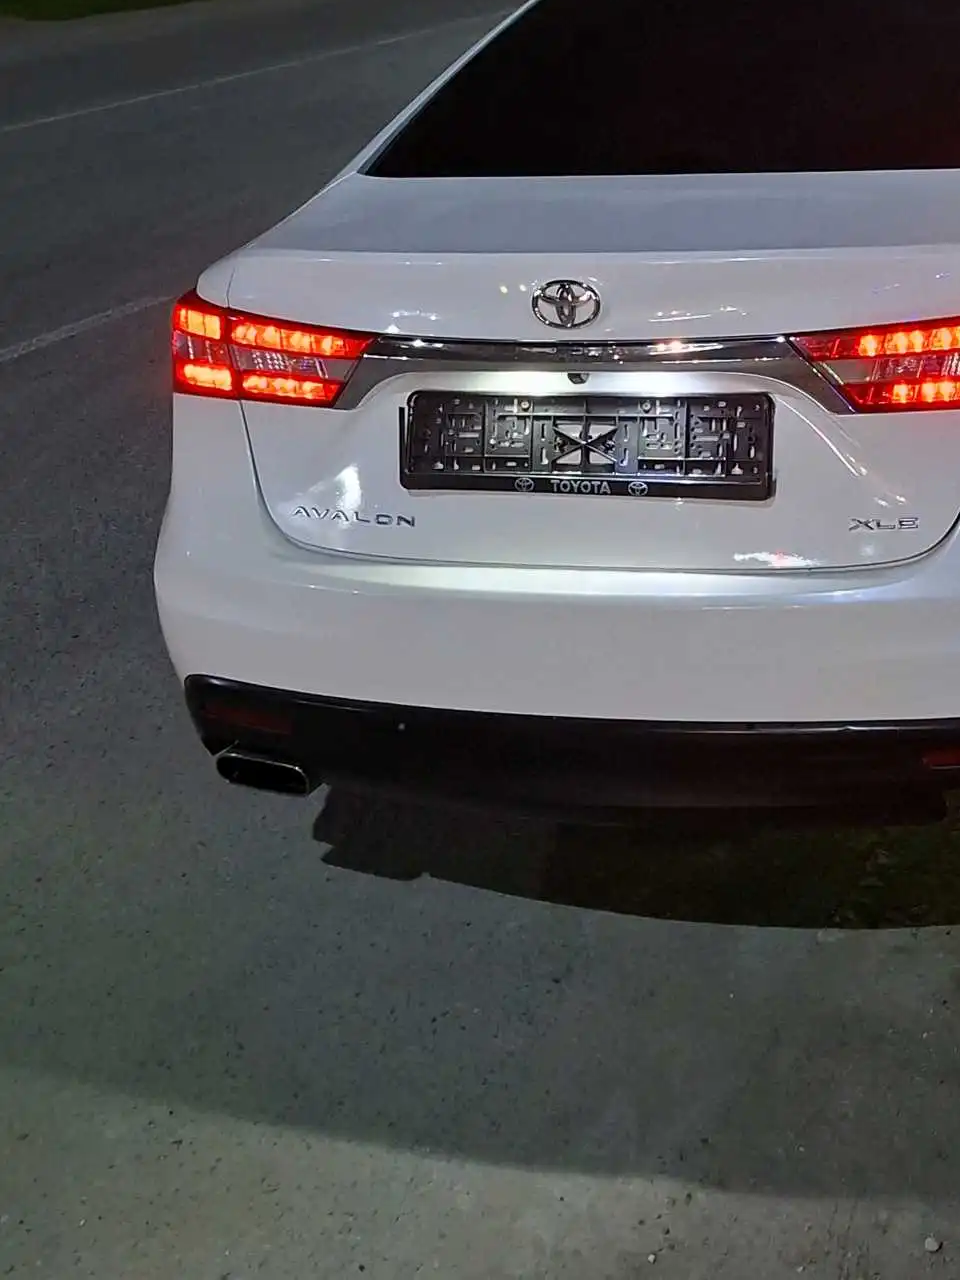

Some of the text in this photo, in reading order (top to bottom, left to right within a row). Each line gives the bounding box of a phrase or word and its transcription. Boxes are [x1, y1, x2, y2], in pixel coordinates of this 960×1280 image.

[550, 479, 612, 494] TOYOTA
[292, 505, 416, 528] AVALON
[848, 517, 919, 531] XLE
